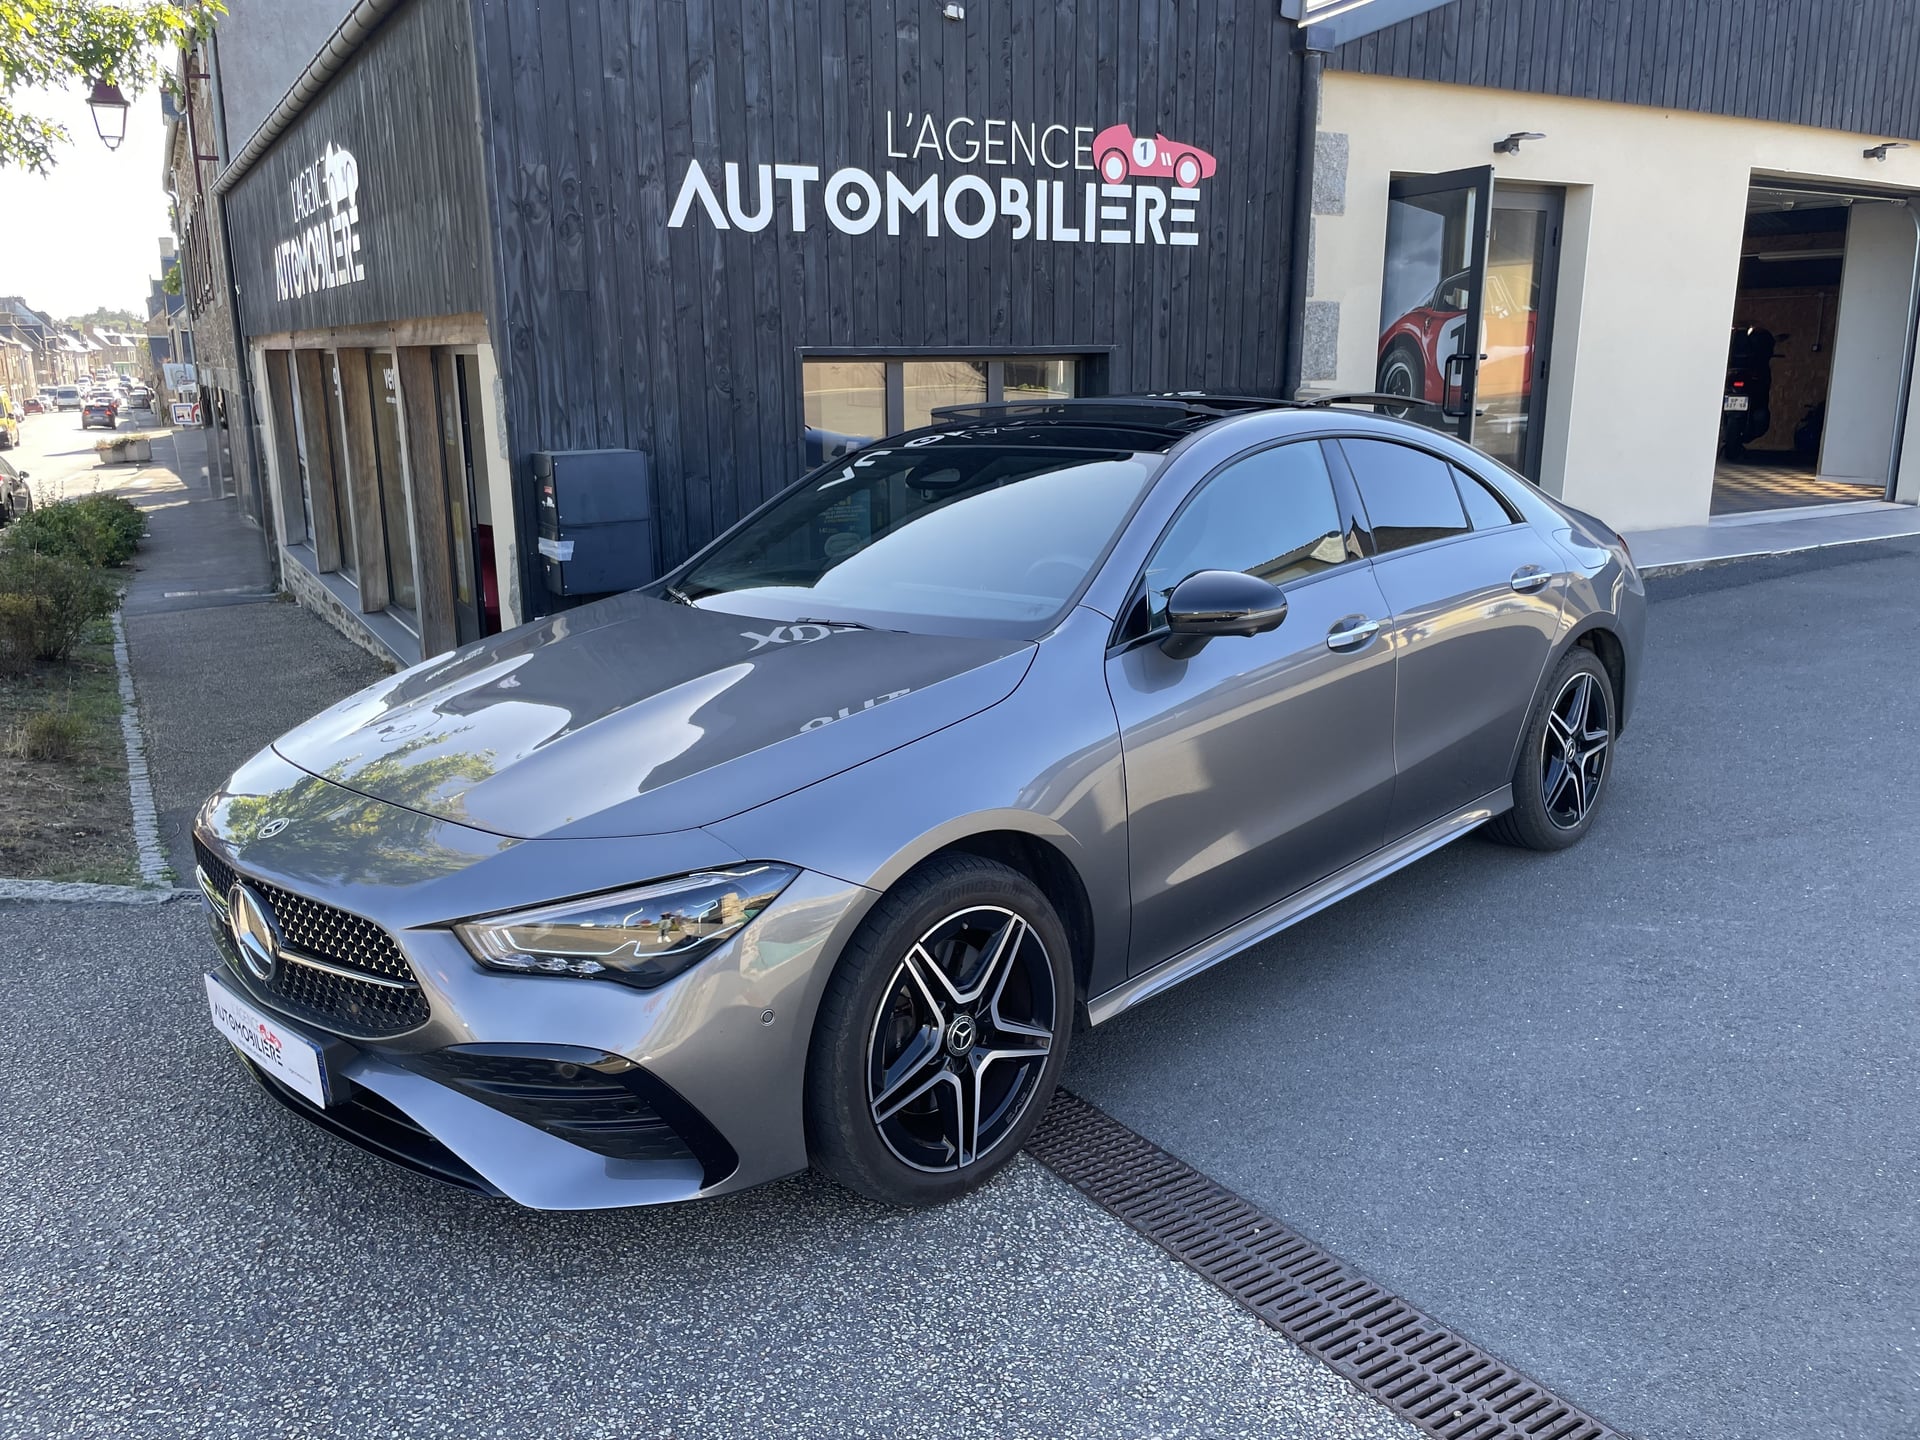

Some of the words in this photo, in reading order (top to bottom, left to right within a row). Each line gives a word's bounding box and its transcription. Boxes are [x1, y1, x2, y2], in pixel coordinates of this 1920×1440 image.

[887, 110, 1094, 171] L'AGENCE
[1139, 141, 1148, 161] 1
[667, 159, 1199, 246] AUTOMOBILIERE
